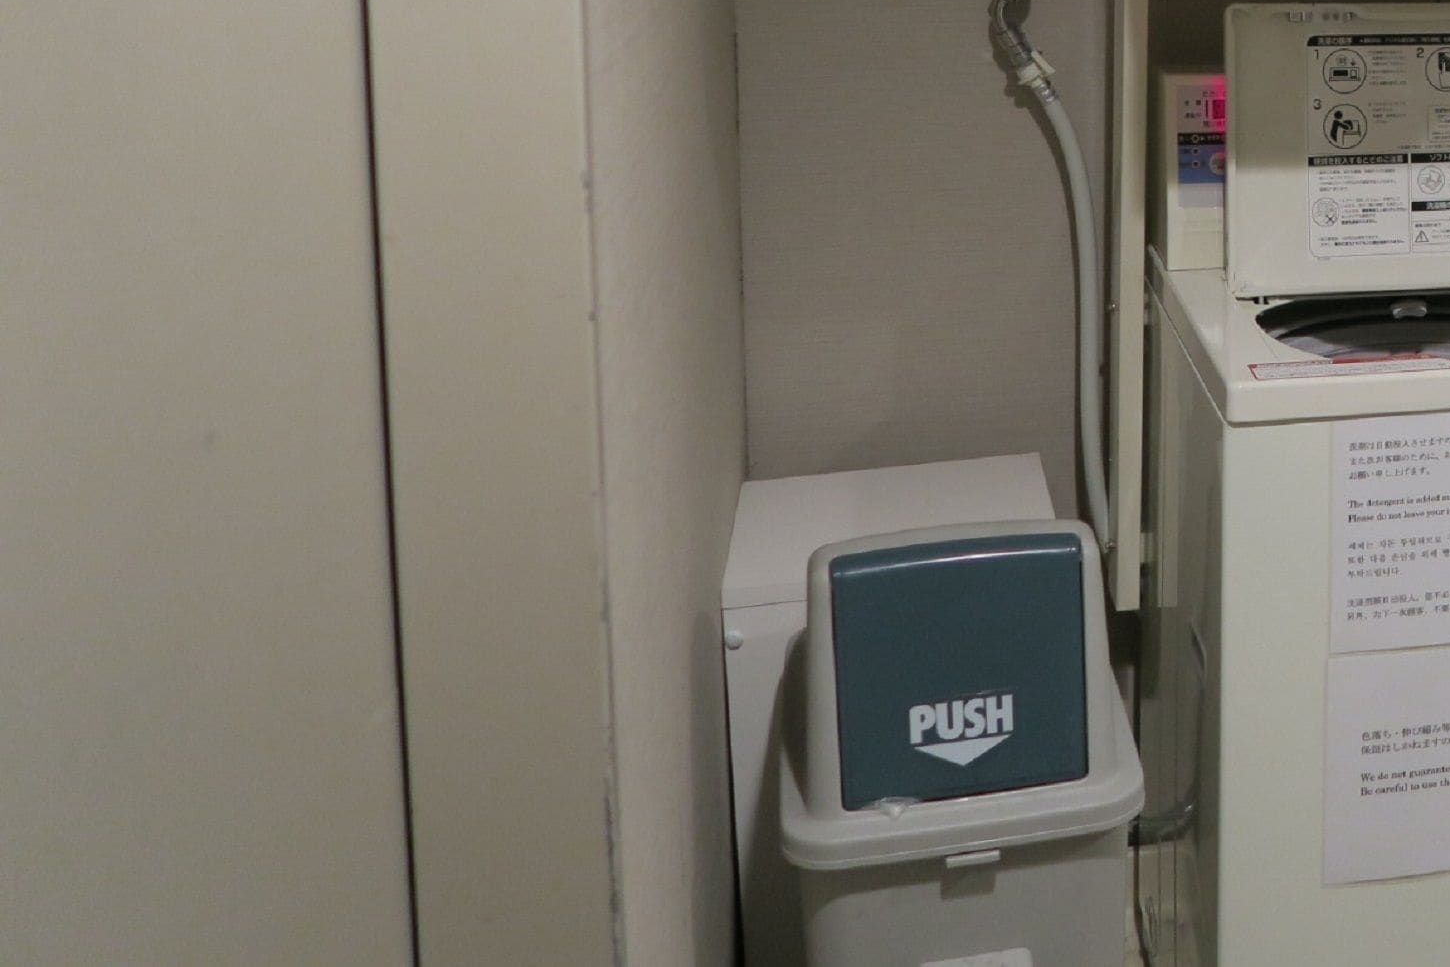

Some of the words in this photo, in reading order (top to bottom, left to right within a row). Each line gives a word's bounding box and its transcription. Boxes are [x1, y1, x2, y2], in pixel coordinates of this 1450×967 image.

[1313, 49, 1319, 60] 1
[1416, 47, 1424, 59] 2
[1313, 99, 1322, 110] 3
[1348, 499, 1364, 509] The
[1366, 497, 1405, 508] detergent
[1407, 496, 1414, 505] is
[1415, 494, 1440, 504] added
[1347, 514, 1374, 524] Please
[1376, 513, 1387, 521] do
[1388, 511, 1402, 520] not
[1404, 510, 1425, 520] leave
[1426, 509, 1445, 519] your
[909, 694, 1014, 744] PUSH
[1361, 772, 1375, 782] We
[1377, 771, 1389, 780] do
[1391, 770, 1407, 779] not
[1361, 786, 1374, 797] Be
[1375, 782, 1408, 795] careful
[1410, 783, 1420, 791] to
[1421, 781, 1438, 789] use
